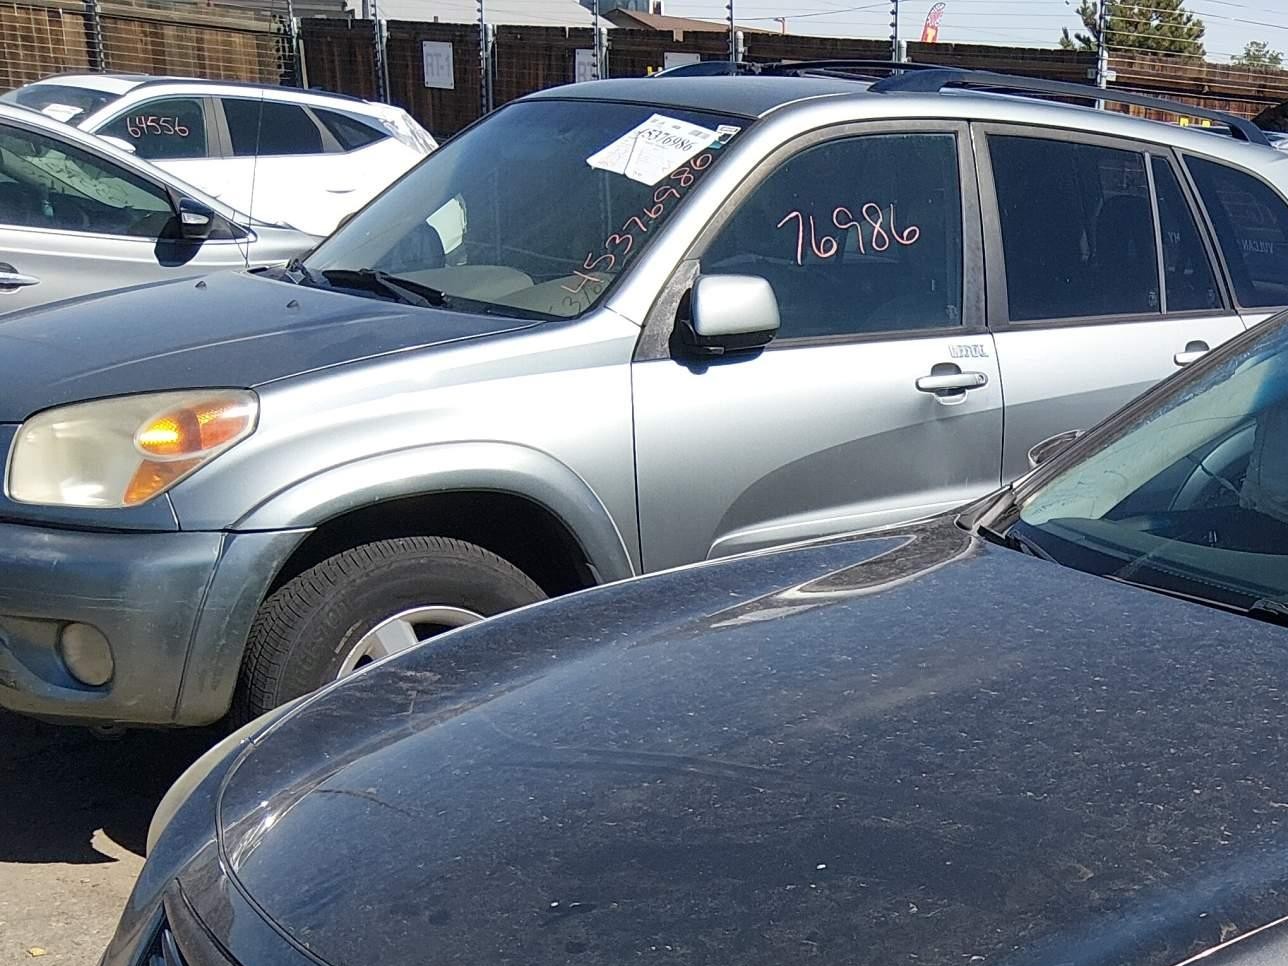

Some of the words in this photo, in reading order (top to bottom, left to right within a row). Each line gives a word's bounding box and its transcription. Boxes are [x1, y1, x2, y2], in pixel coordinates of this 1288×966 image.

[126, 115, 189, 138] 64556
[561, 153, 712, 293] 45376986
[776, 202, 920, 265] 76986
